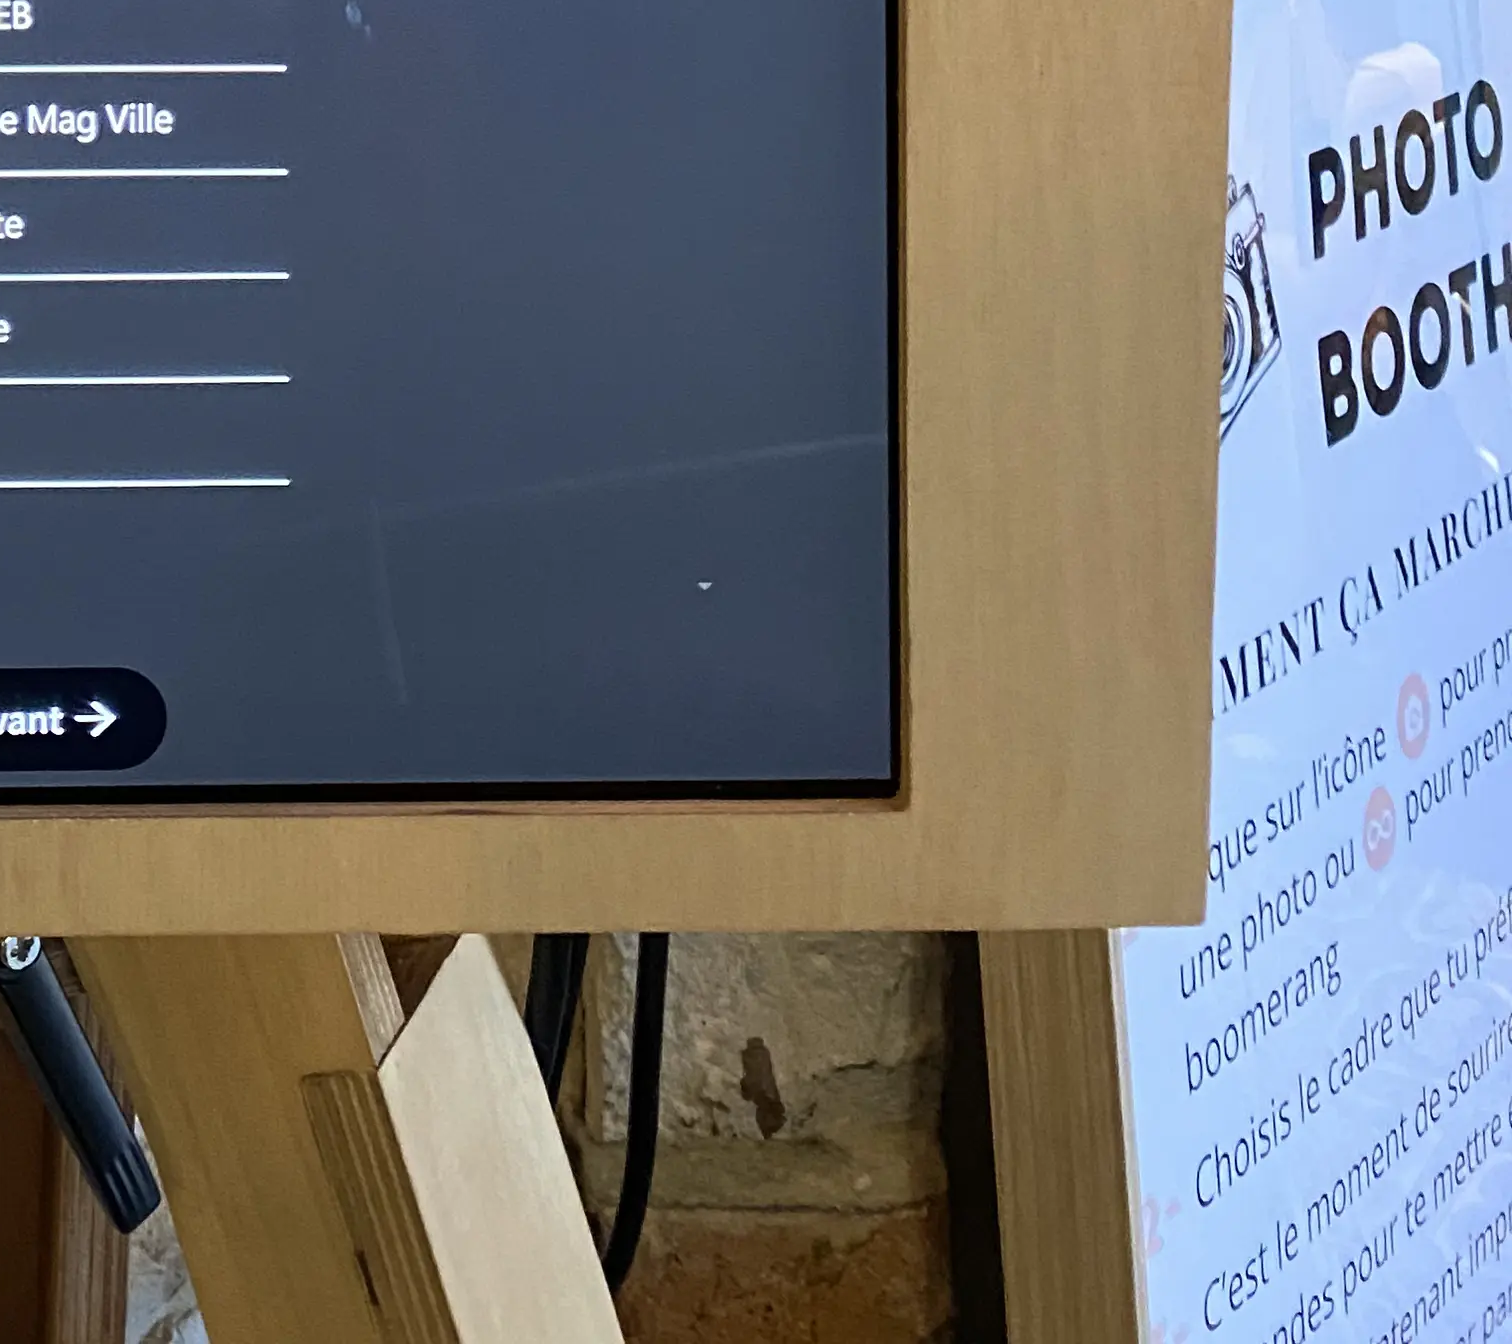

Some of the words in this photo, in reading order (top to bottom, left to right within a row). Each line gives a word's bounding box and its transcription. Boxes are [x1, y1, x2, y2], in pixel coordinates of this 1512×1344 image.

[26, 103, 99, 144] Mag
[105, 102, 175, 135] Ville
[1308, 79, 1503, 259] PHOTO
[1317, 241, 1512, 447] BOOTH
[1214, 596, 1325, 715] MENT
[1339, 564, 1384, 645] ÇA
[1266, 780, 1305, 842] sur
[1312, 726, 1388, 809] l'icône
[1440, 648, 1487, 728] pour
[1180, 932, 1233, 999] une
[1241, 869, 1317, 972] photo
[1324, 838, 1355, 889] ou
[1404, 758, 1454, 842] pour
[1185, 941, 1342, 1097] boomerang
[1196, 1098, 1292, 1208] Choisis
[1298, 1073, 1321, 1124] le
[1328, 1016, 1393, 1096] cadre
[1400, 968, 1441, 1040] que
[1446, 943, 1468, 988] tu
[1204, 1242, 1270, 1332] C'est
[1276, 1219, 1299, 1271] le
[1307, 1112, 1410, 1243] moment
[1415, 1085, 1441, 1138] de
[1342, 1215, 1398, 1315] pour
[1405, 1191, 1427, 1237] te
[1433, 1113, 1503, 1211] mettre
